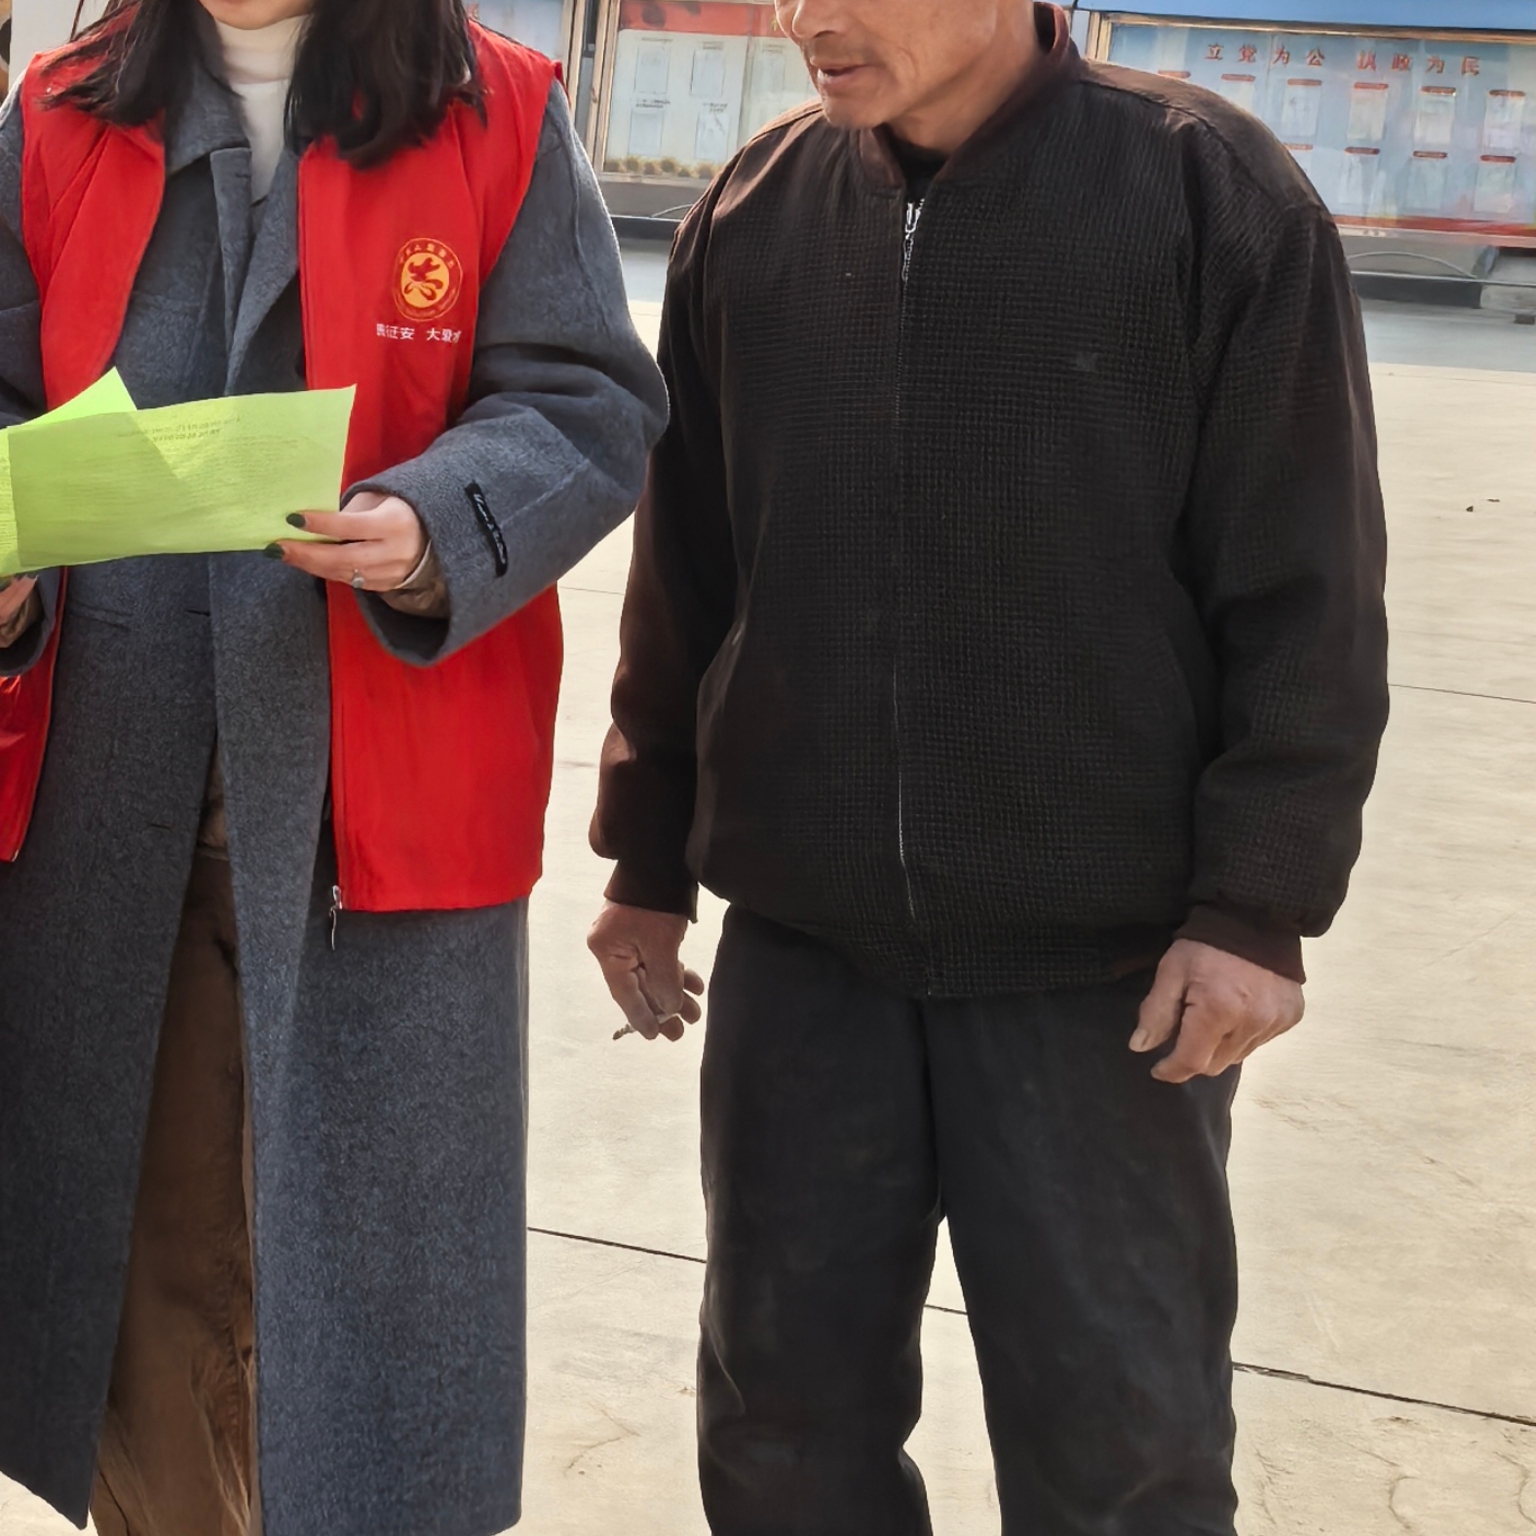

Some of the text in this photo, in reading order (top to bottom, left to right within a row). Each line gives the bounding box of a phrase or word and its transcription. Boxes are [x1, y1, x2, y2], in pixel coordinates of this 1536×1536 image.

[1205, 43, 1481, 76] 立党为公 执政为民
